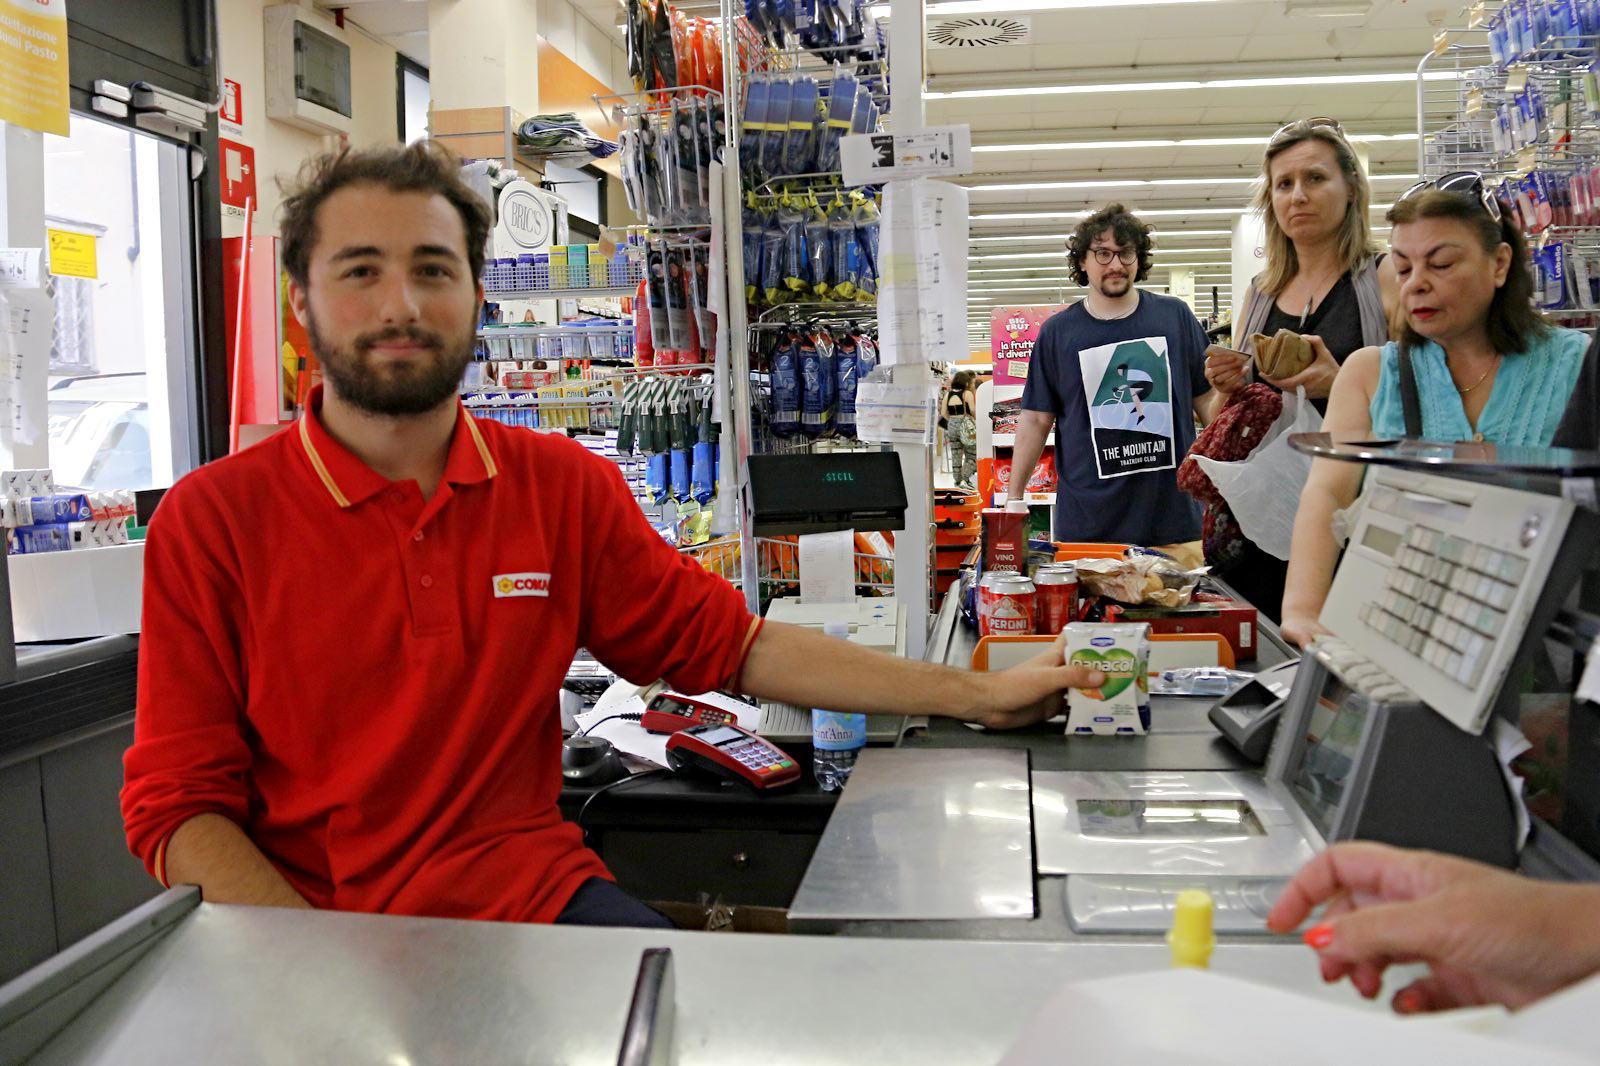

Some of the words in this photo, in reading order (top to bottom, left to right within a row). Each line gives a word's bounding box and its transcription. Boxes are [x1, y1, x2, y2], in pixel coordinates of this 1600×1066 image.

[1008, 317, 1026, 325] BIG
[1005, 323, 1030, 331] FRUT
[1001, 341, 1009, 350] la
[997, 350, 1004, 359] si
[1006, 349, 1033, 358] divert
[1102, 446, 1120, 461] THE
[1122, 440, 1166, 458] MOUNTAIN
[1143, 455, 1157, 463] CLUB
[994, 553, 1015, 562] VINO
[989, 619, 1027, 630] PERONI
